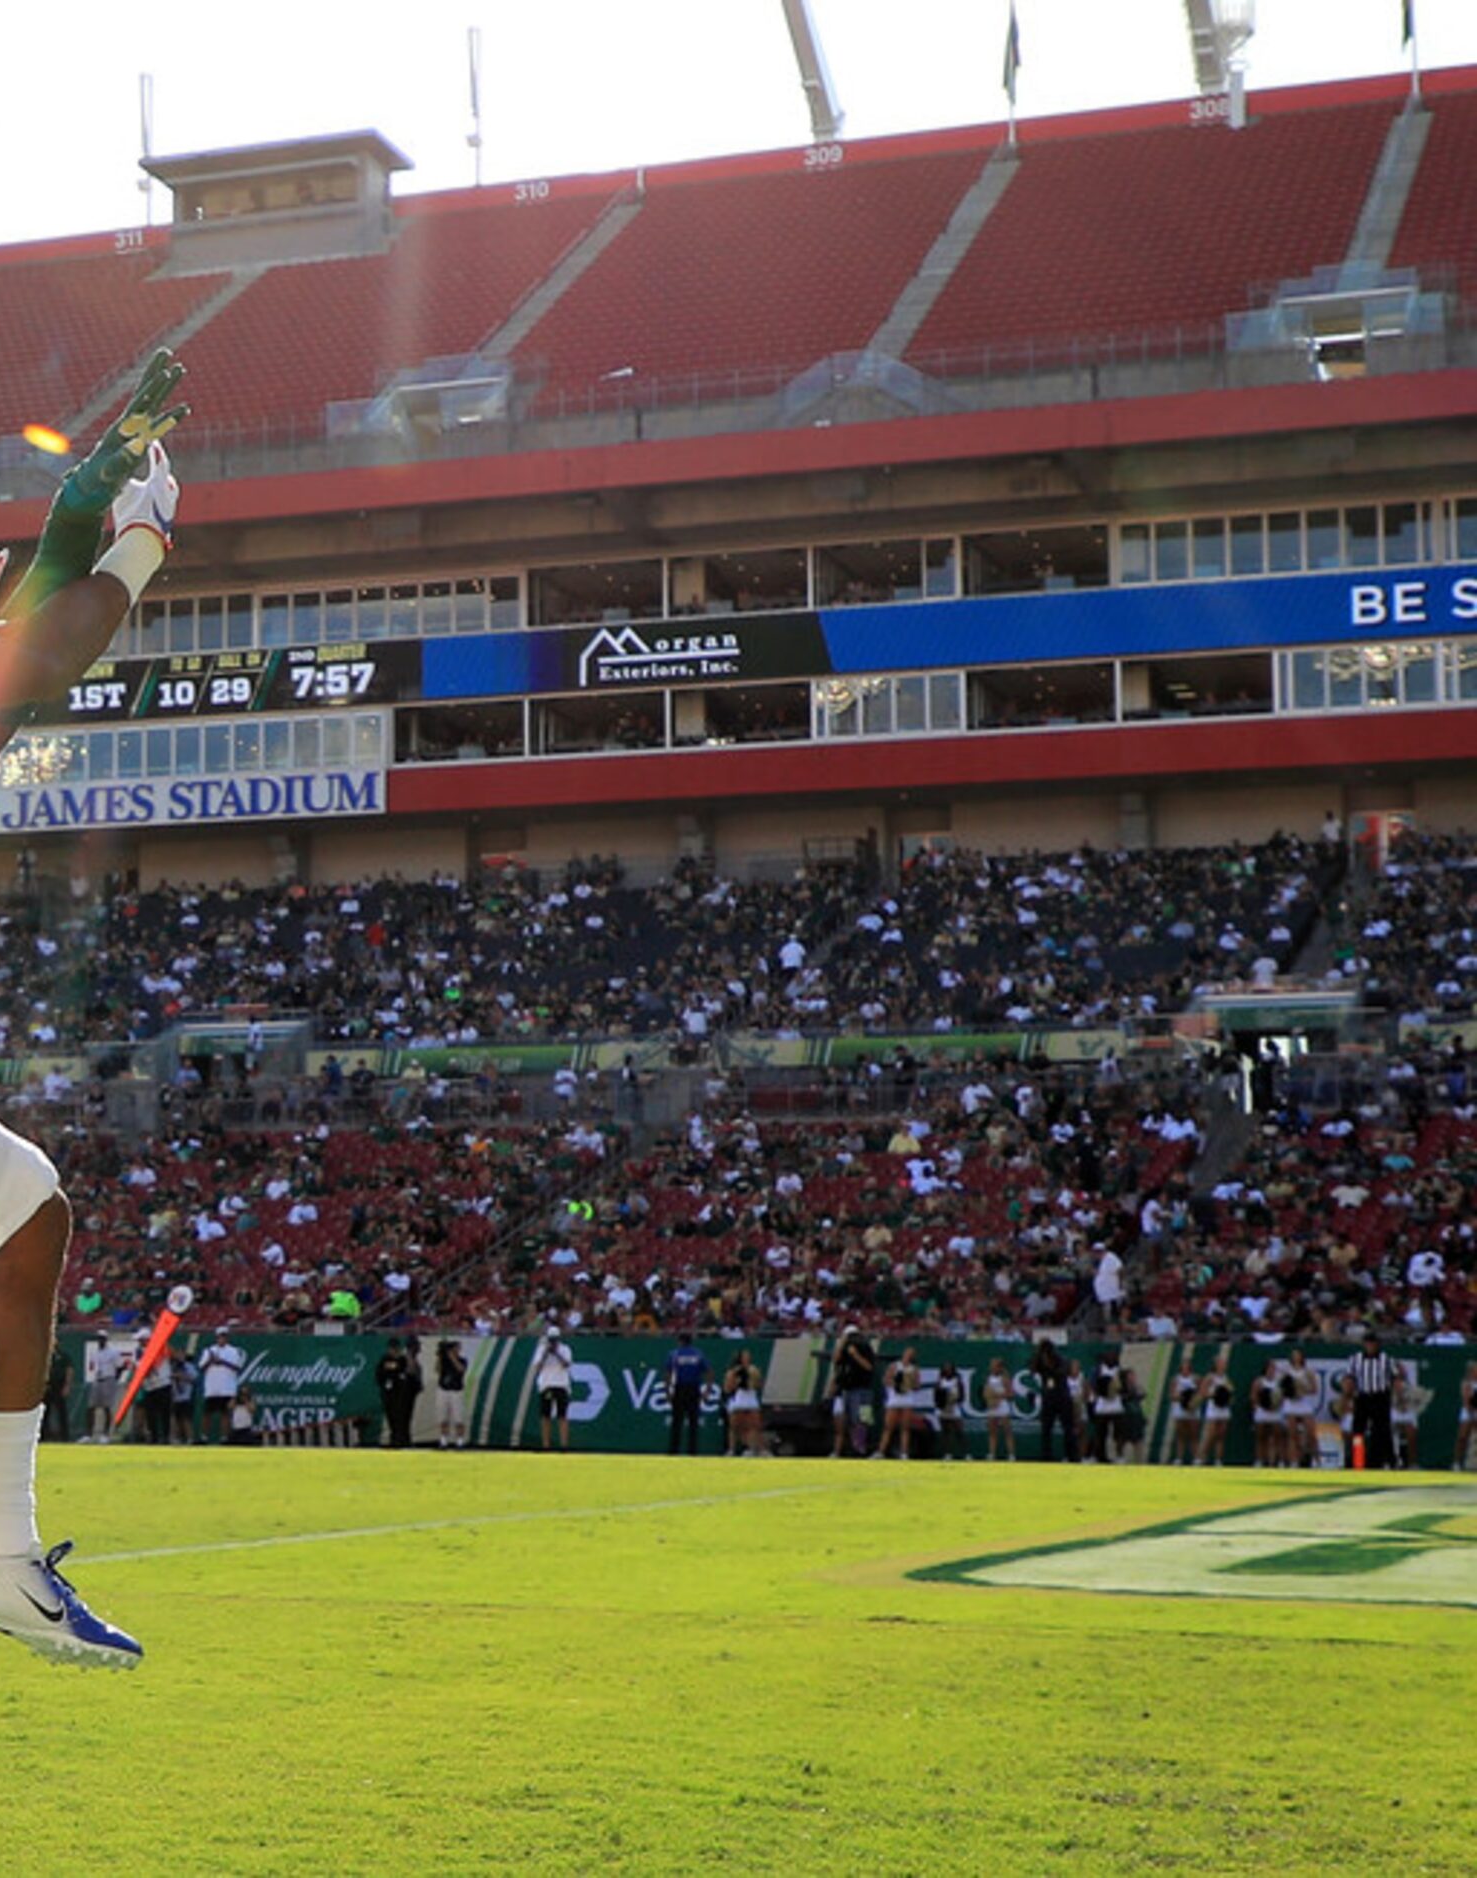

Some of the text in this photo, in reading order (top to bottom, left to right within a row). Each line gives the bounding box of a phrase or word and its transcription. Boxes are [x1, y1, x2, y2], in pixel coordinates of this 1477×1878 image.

[804, 145, 842, 165] 309
[515, 181, 549, 200] 310
[1351, 582, 1427, 625] BE
[290, 662, 375, 699] 7:57
[598, 659, 739, 681] Exteriors, Inc.
[68, 682, 127, 711] 1ST
[158, 680, 196, 707] 10
[210, 677, 251, 705] 29
[1, 783, 155, 829] JAMES
[168, 770, 381, 821] STADIUM
[251, 1406, 336, 1432] AGER
